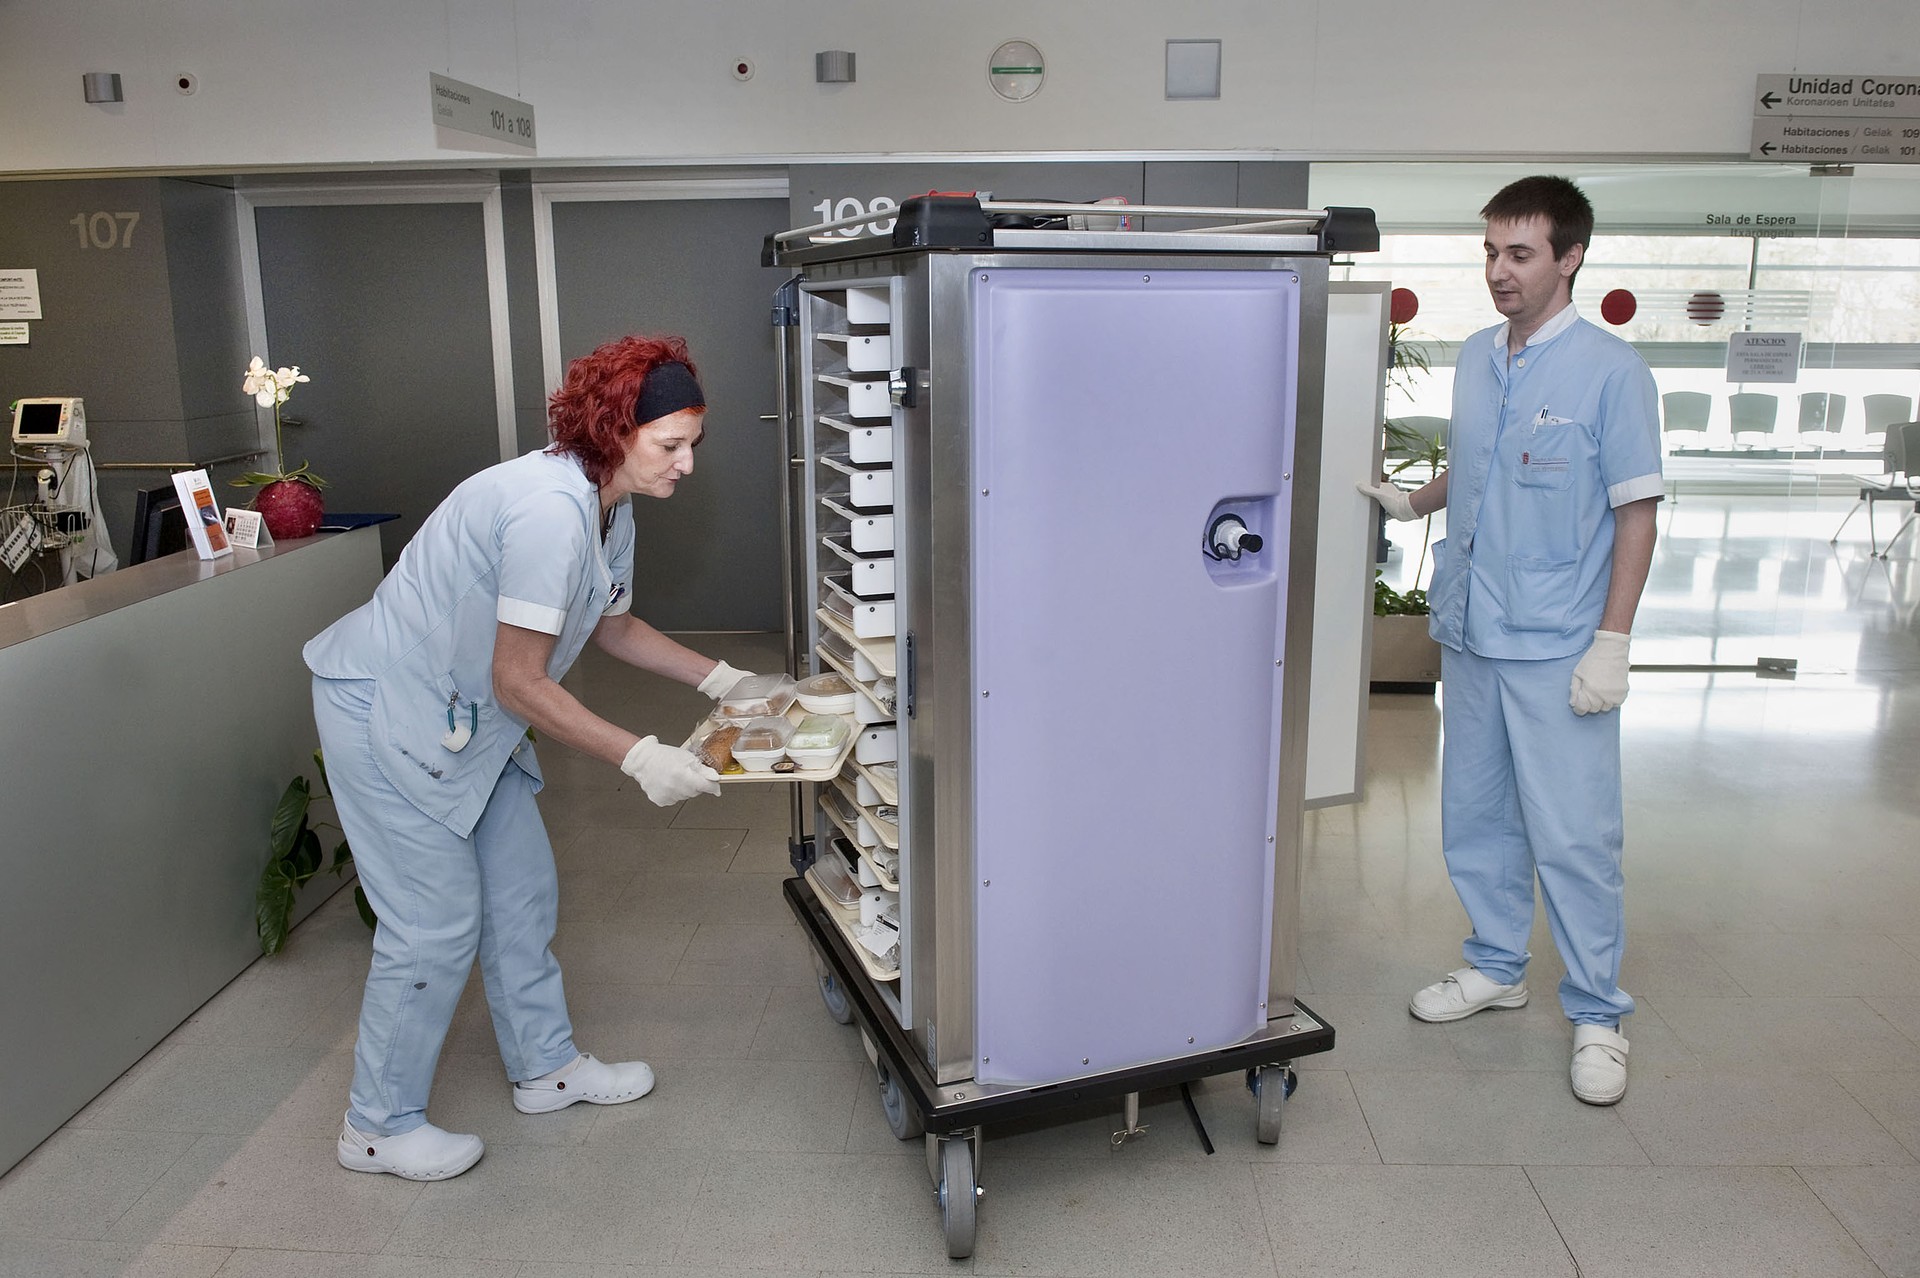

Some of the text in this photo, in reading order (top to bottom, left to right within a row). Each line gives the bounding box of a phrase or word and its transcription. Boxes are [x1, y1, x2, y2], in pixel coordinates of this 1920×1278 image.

[435, 84, 470, 104] Habitaciones
[1788, 78, 1920, 96] Unidad Coron
[1786, 96, 1895, 108] Koronarioen Unitatea
[490, 109, 532, 138] 101 a 108
[1783, 127, 1850, 138] Habitaciones
[1863, 127, 1893, 137] Gelak
[1781, 144, 1848, 155] Habitaciones
[1861, 144, 1890, 155] Gelak
[1899, 146, 1915, 156] 101
[813, 196, 898, 237] 108
[1706, 214, 1796, 226] Sala de Espera
[69, 211, 140, 249] 107
